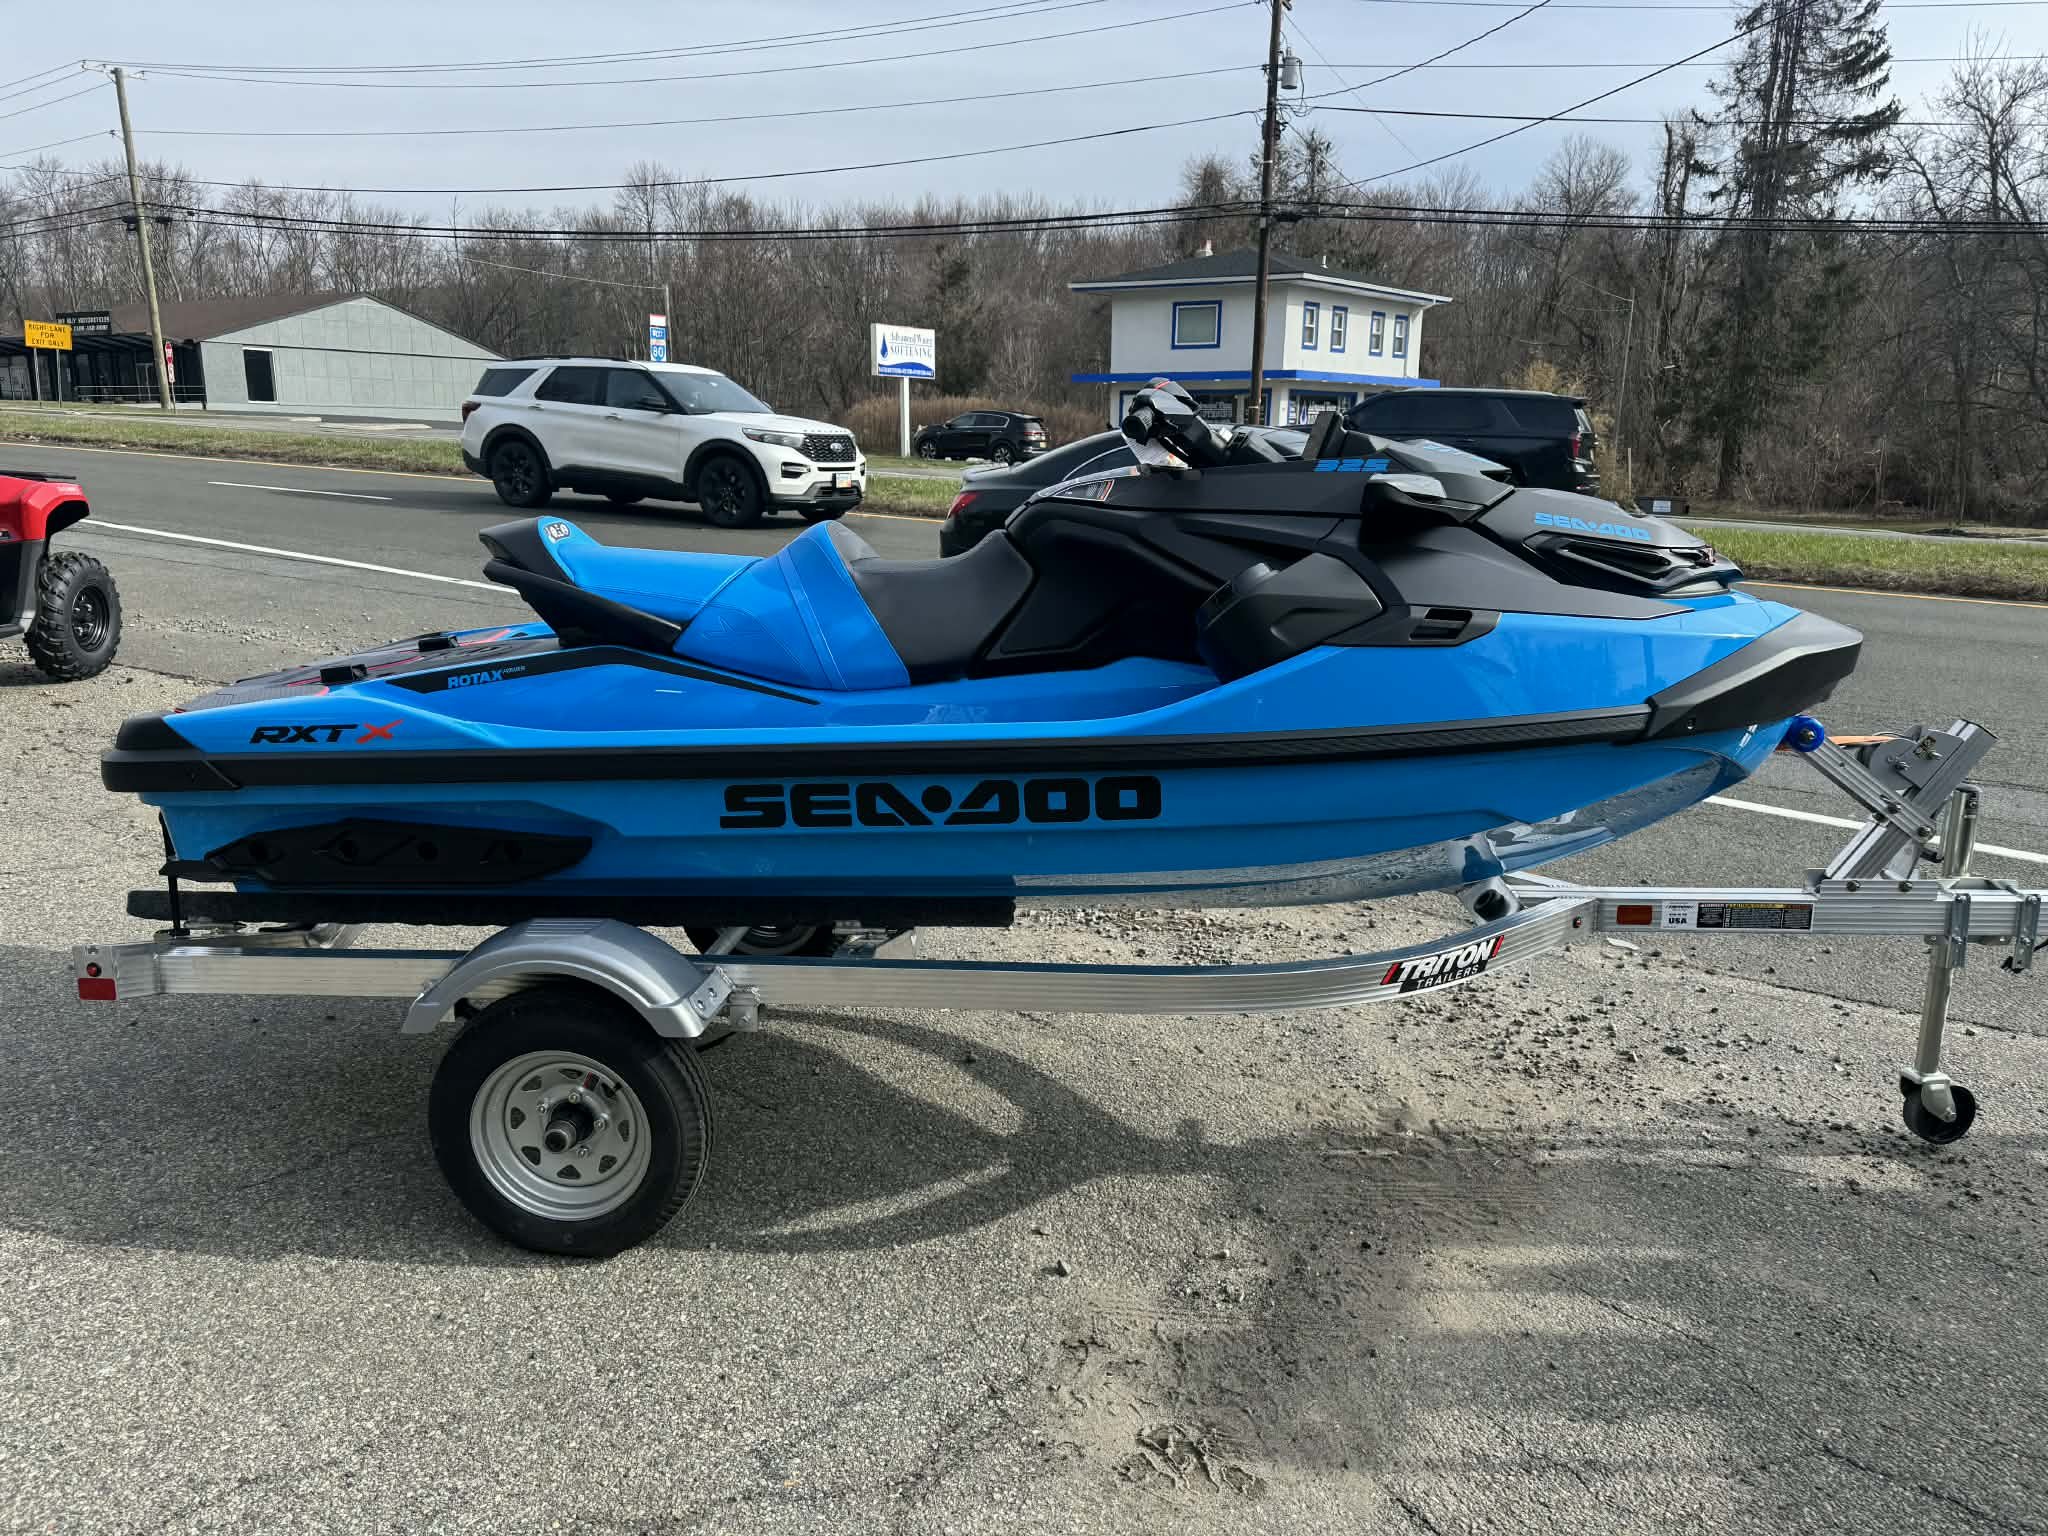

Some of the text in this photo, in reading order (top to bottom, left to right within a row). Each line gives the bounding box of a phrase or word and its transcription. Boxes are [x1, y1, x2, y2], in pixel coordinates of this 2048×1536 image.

[28, 323, 47, 331] RIGHT
[49, 325, 66, 333] LANE
[48, 339, 64, 347] ONLY
[653, 345, 664, 359] 80
[447, 670, 503, 689] ROTAX
[249, 719, 404, 744] RXT X
[1668, 917, 1687, 925] USA
[1397, 937, 1497, 983] TRITON
[1416, 964, 1479, 990] TRAILERS
